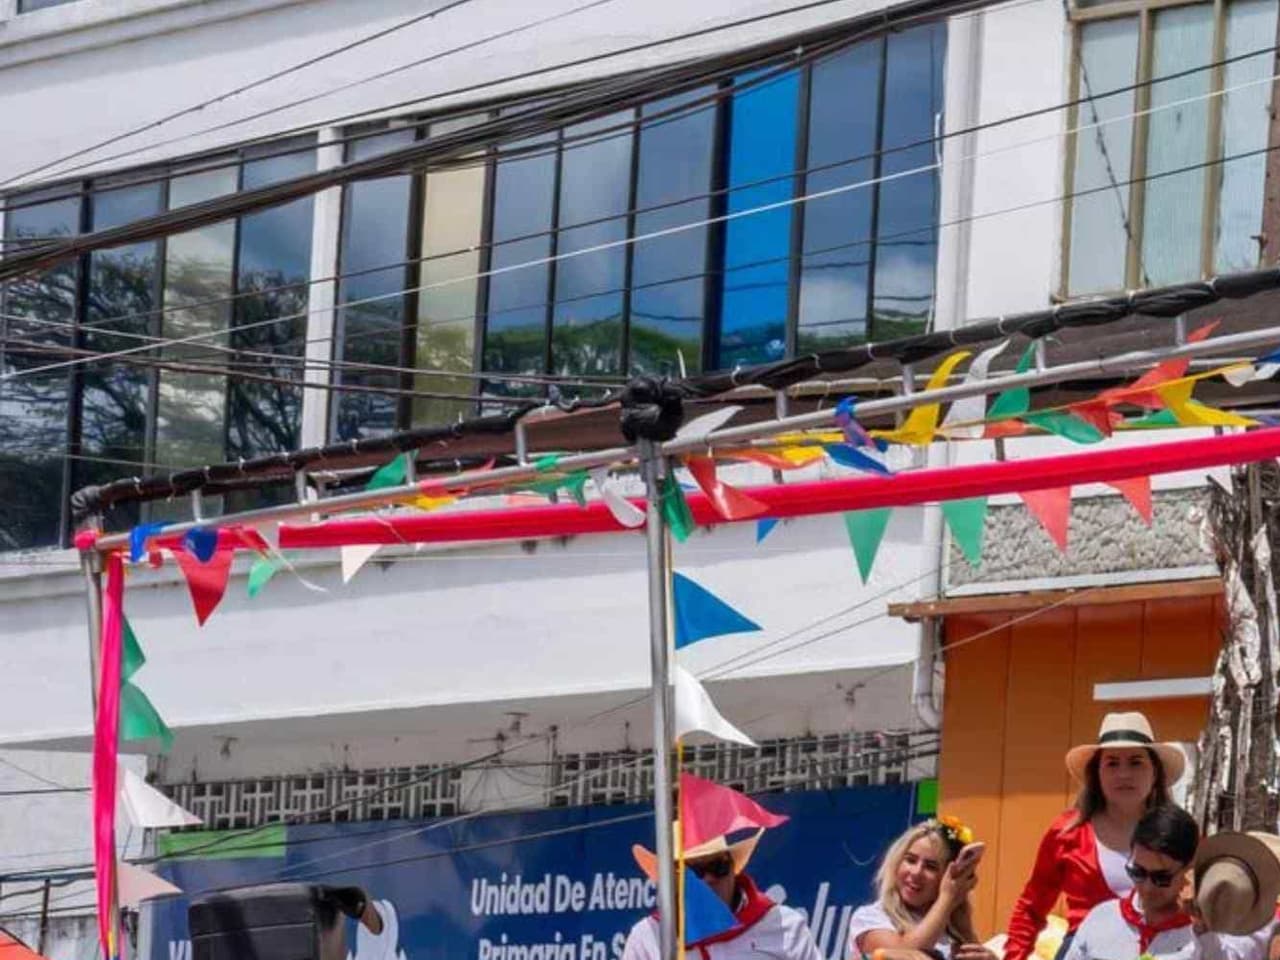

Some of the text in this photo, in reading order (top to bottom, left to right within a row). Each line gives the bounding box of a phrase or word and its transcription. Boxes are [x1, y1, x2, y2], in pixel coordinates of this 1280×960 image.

[471, 872, 656, 916] Unidad De Atenc
